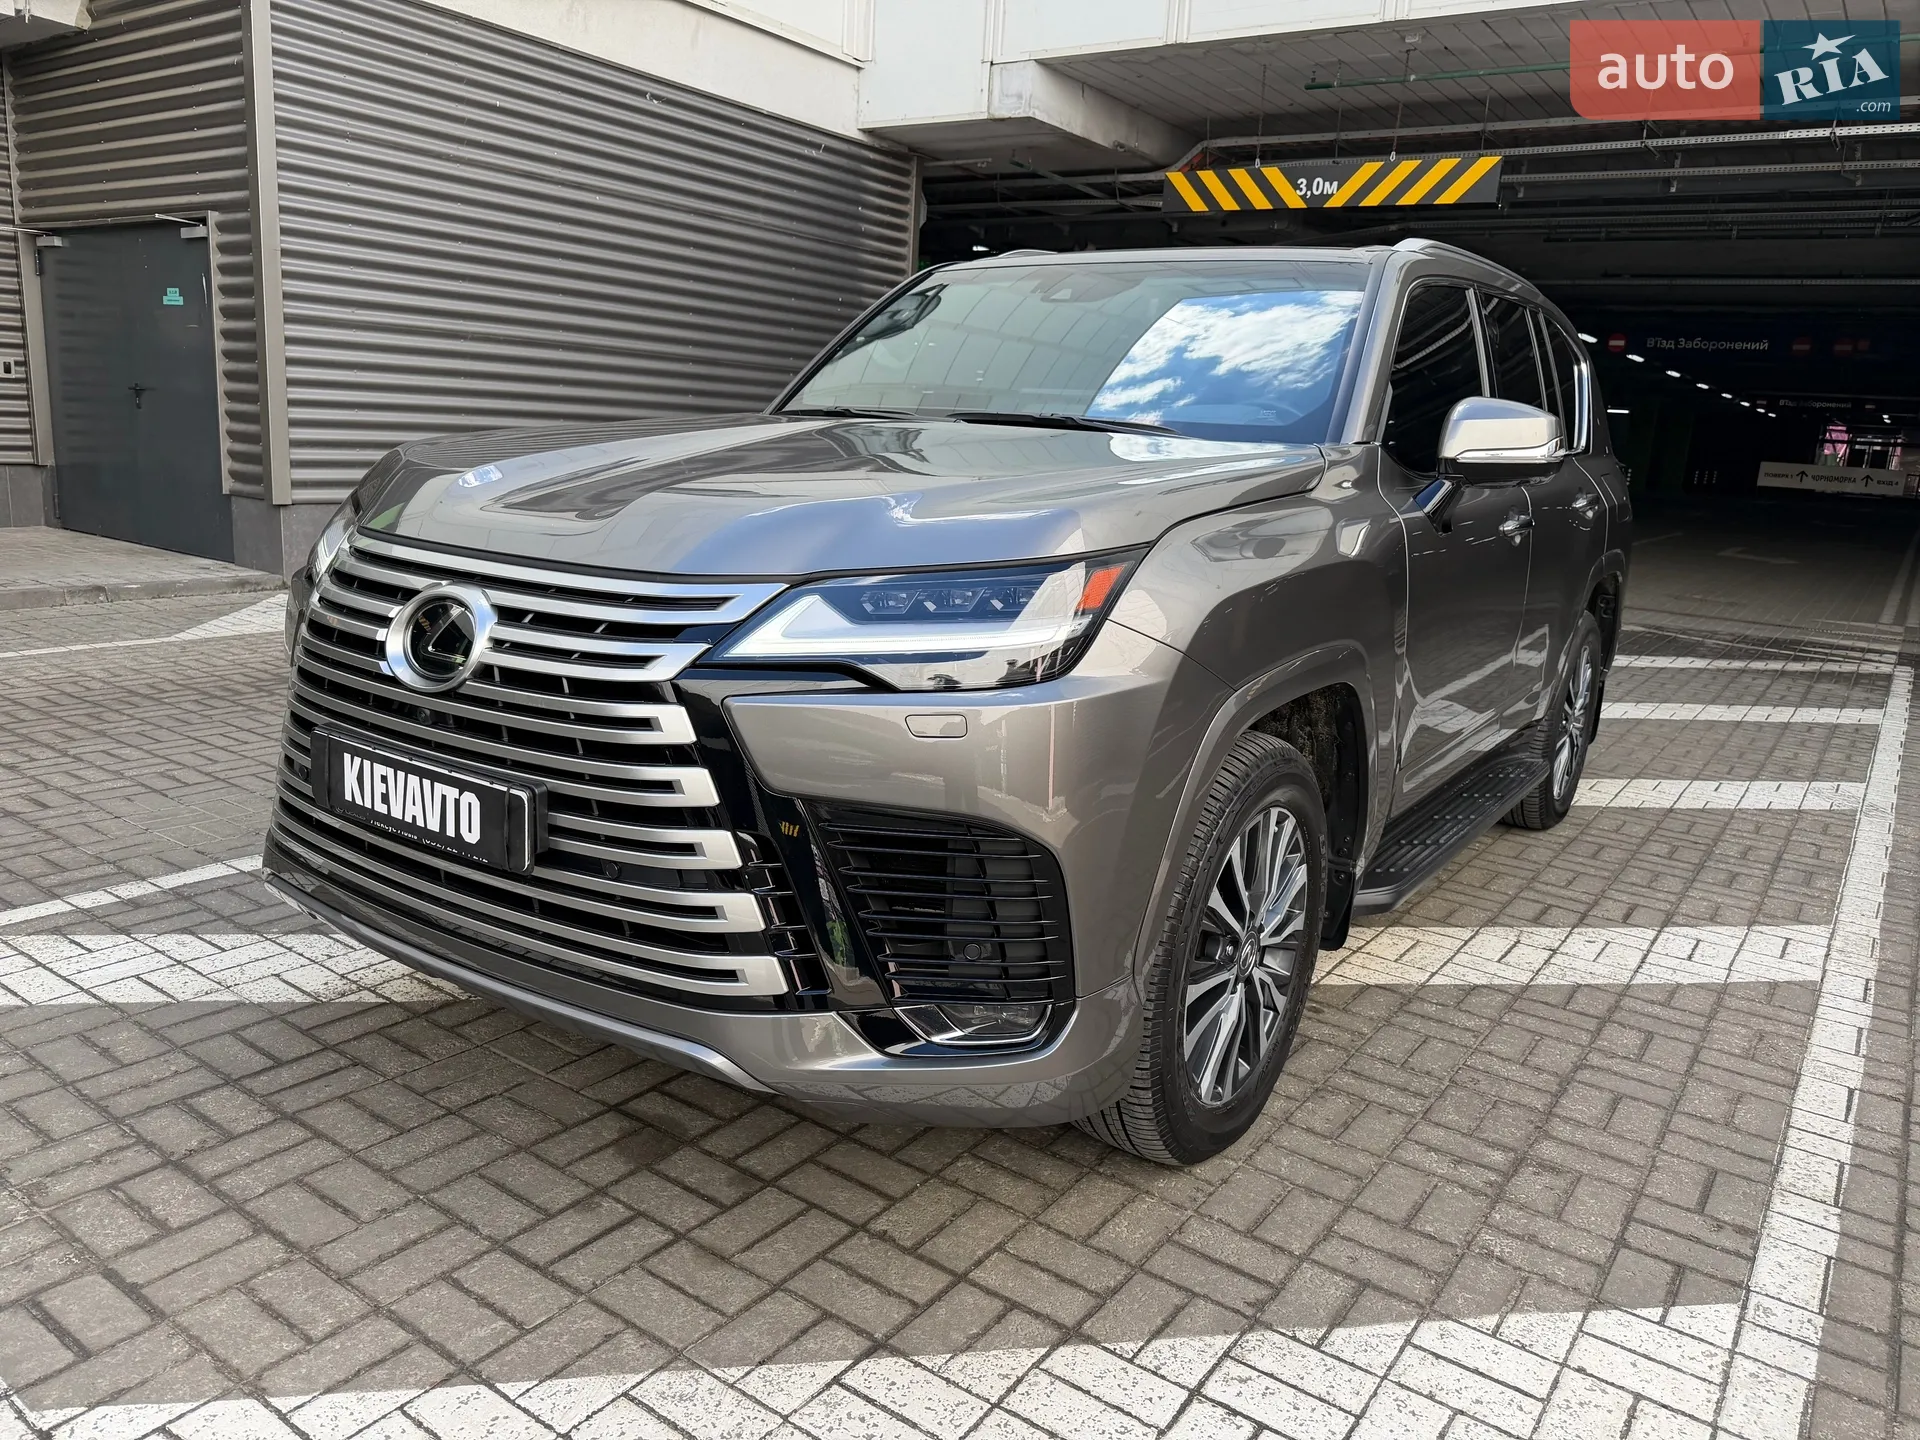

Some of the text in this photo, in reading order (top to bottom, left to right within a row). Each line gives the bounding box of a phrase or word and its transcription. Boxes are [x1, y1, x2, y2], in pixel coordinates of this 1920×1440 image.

[1677, 336, 1769, 352] Заборонений
[1811, 474, 1857, 484] ЧОРНОМОРКА
[343, 752, 481, 844] KIEVAVTO
